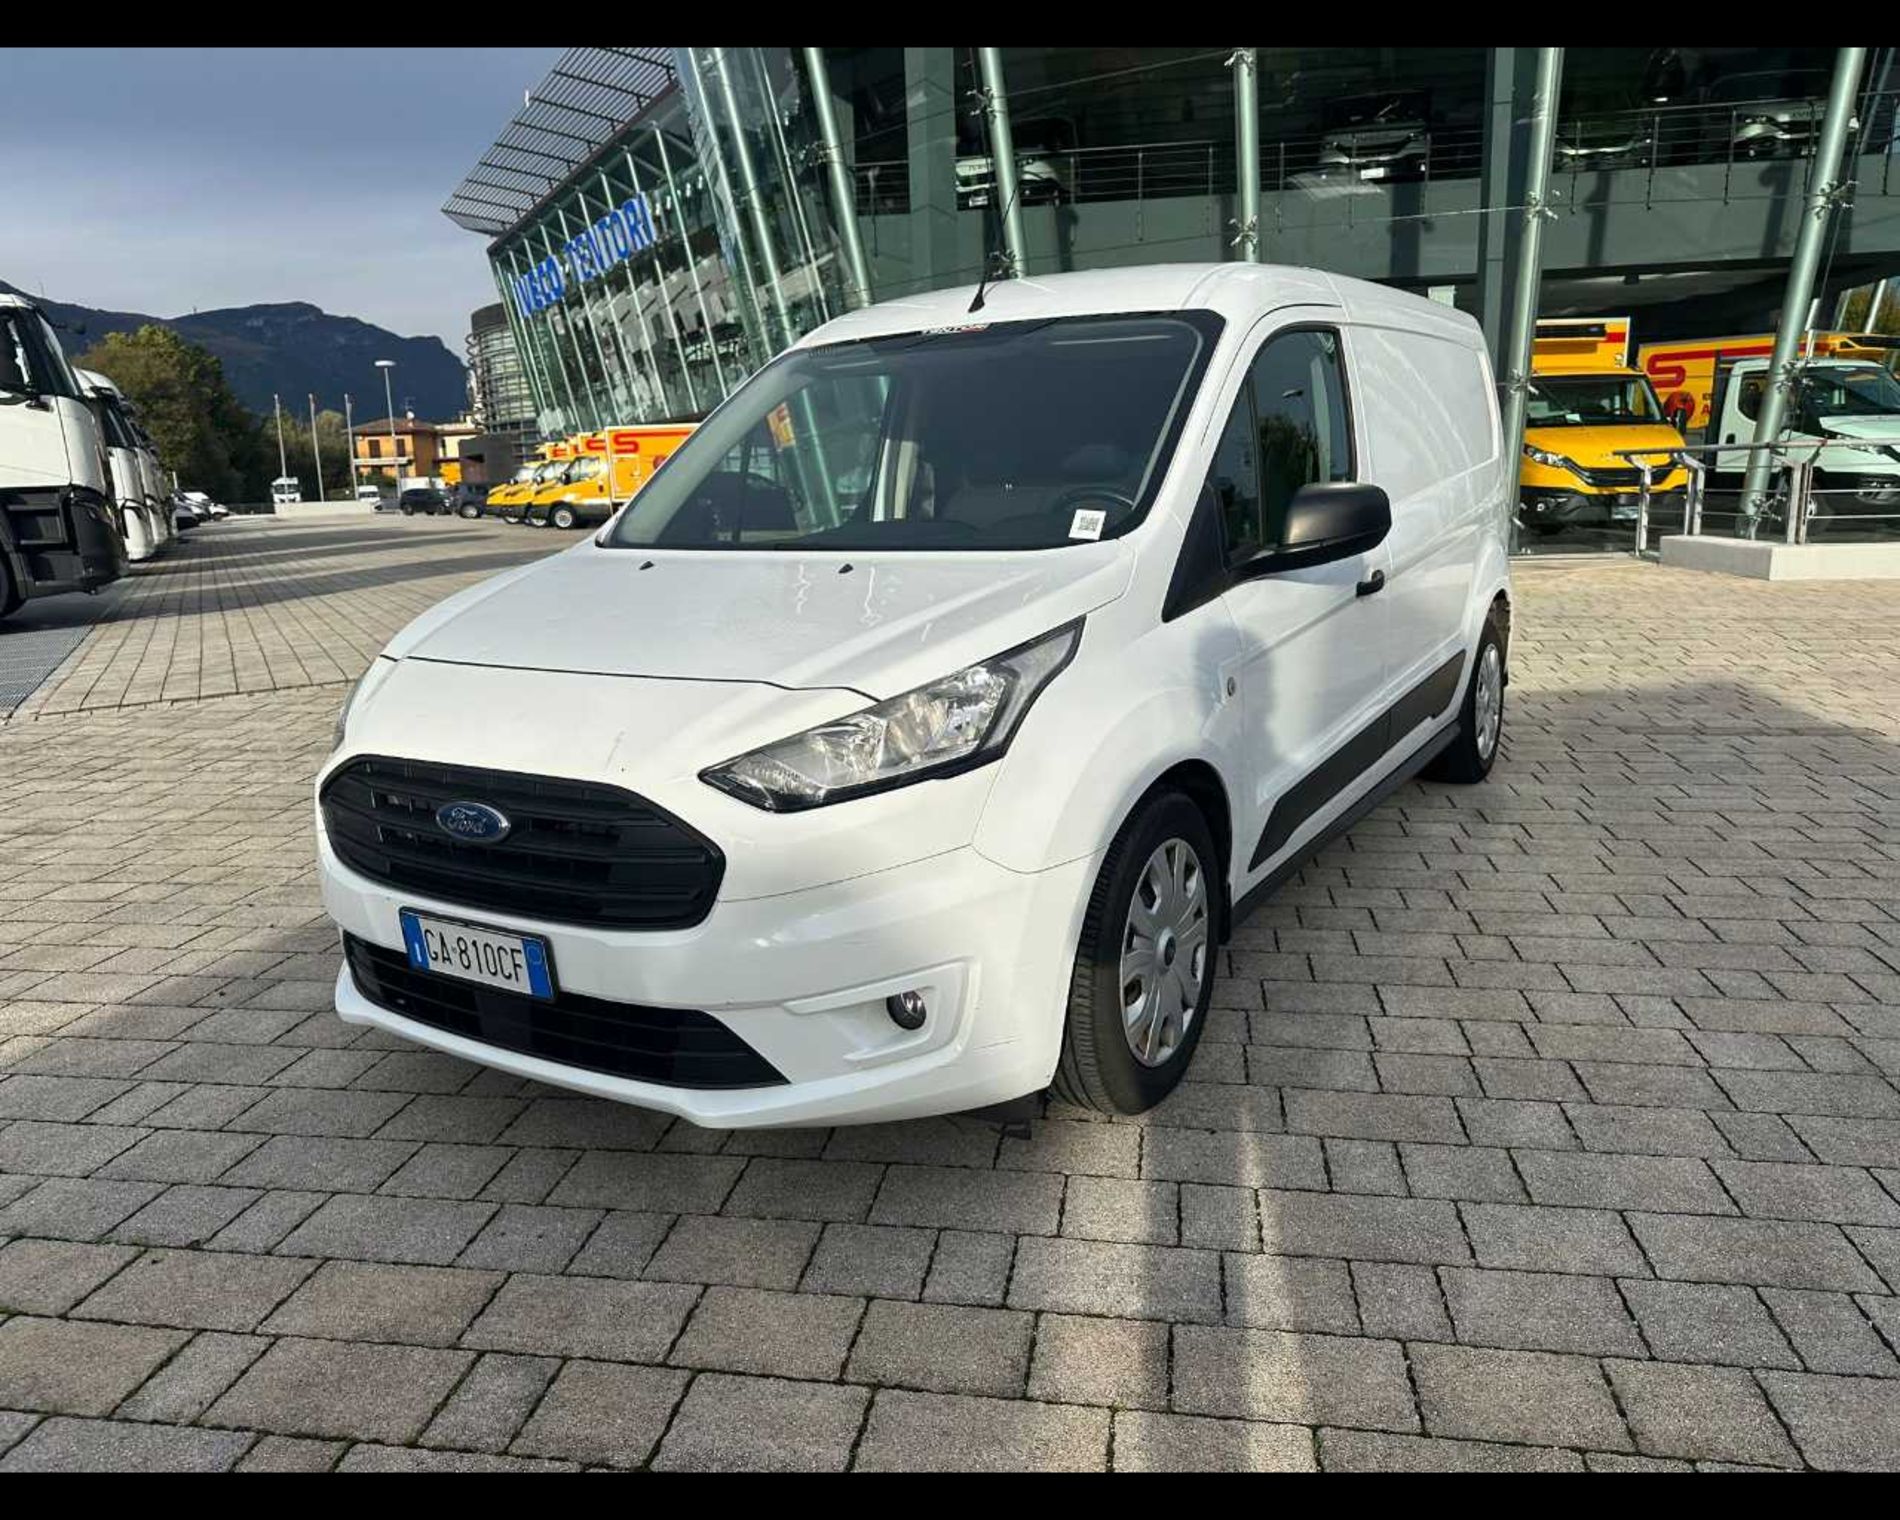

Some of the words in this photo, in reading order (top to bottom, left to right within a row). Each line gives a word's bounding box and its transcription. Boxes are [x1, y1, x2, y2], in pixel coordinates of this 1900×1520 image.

[515, 254, 565, 317] IVECO
[564, 193, 657, 283] TENTORI
[448, 807, 487, 834] Ford
